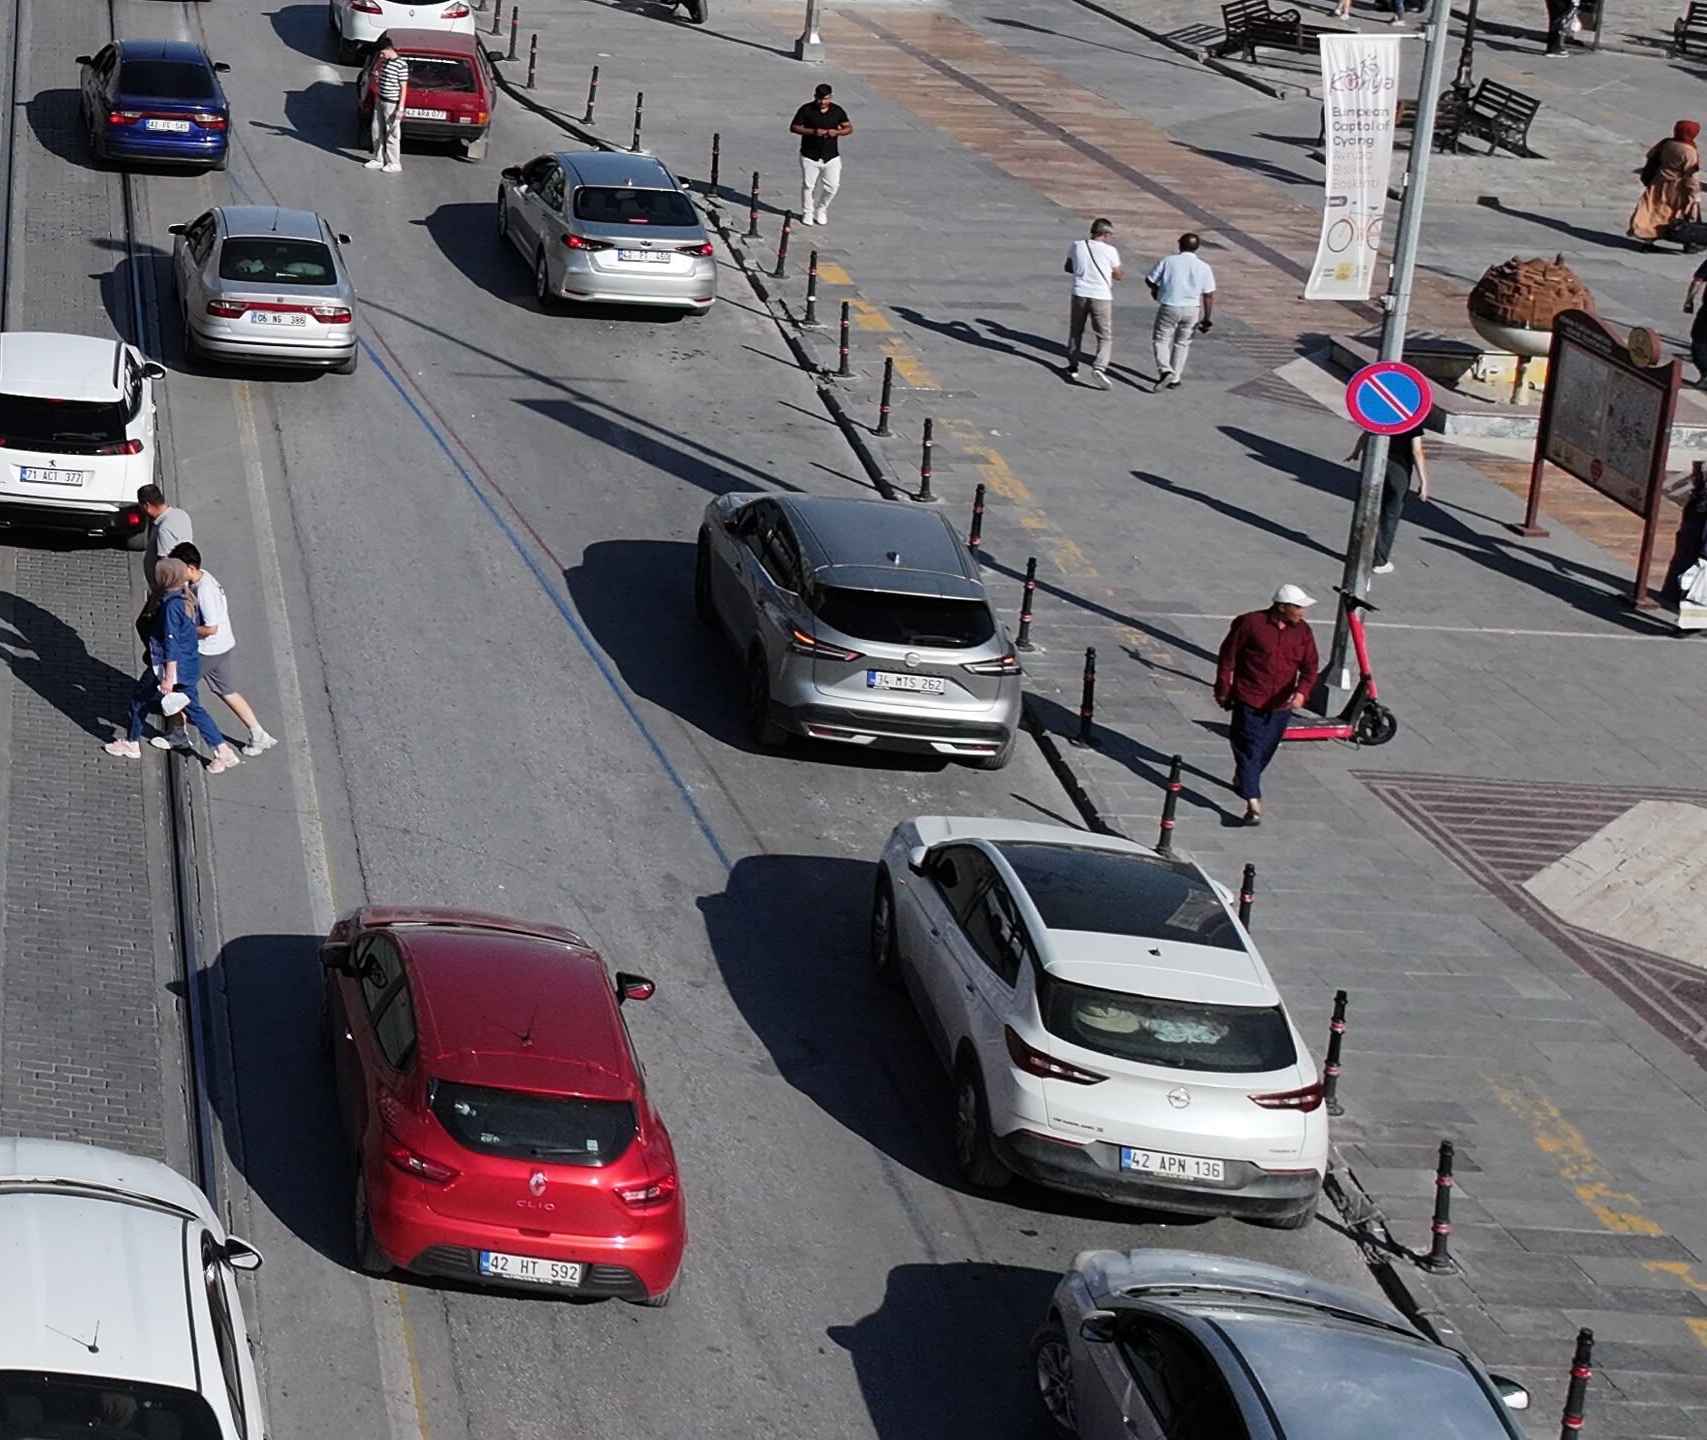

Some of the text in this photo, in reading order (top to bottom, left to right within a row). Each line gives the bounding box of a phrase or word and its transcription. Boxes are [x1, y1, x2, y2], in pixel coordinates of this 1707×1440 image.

[1332, 119, 1378, 133] Captal
[1332, 135, 1375, 148] Cycing
[27, 469, 82, 483] 71 ACT 377
[877, 675, 942, 691] 34 MTS 262
[1131, 1154, 1220, 1178] 42 APN 136
[515, 1199, 555, 1210] CLIO
[490, 1255, 509, 1272] 42
[521, 1259, 538, 1275] HT
[550, 1263, 579, 1281] 592
